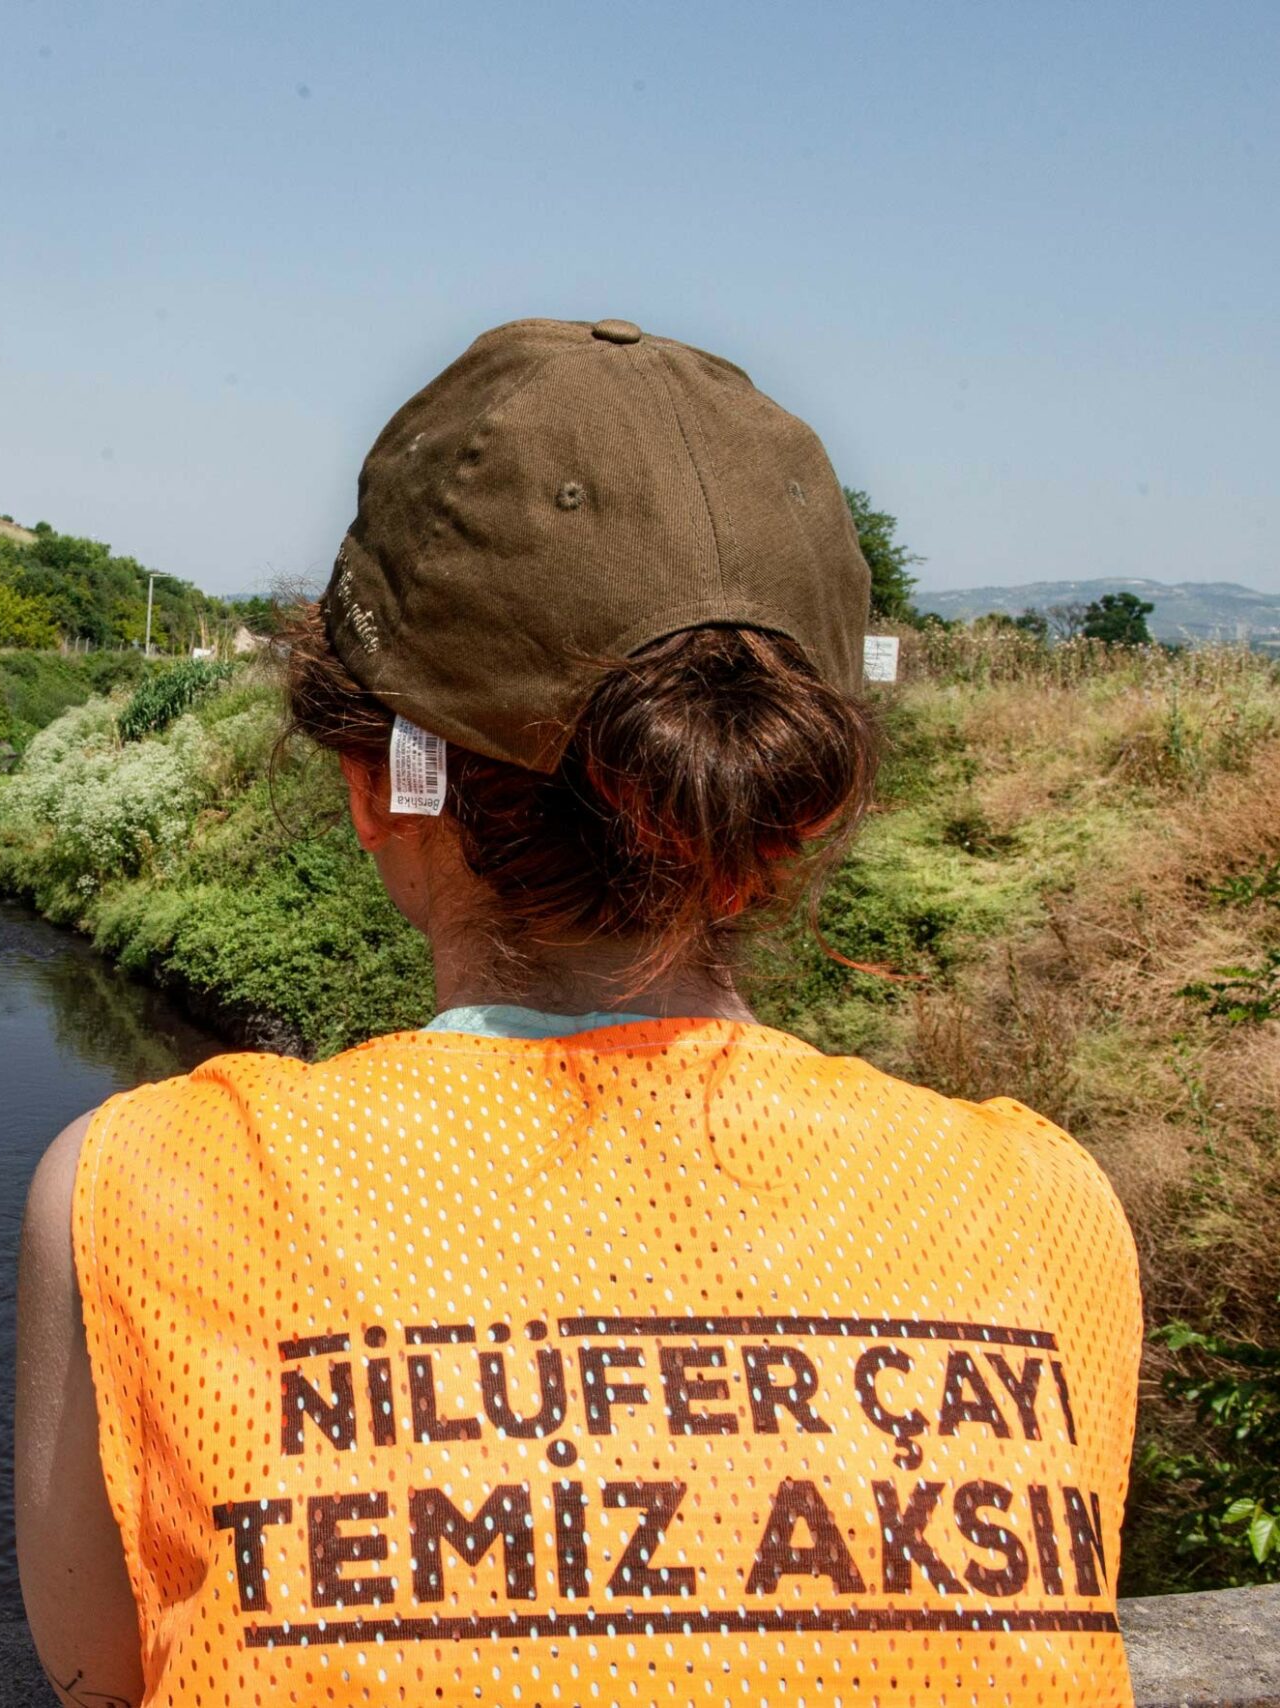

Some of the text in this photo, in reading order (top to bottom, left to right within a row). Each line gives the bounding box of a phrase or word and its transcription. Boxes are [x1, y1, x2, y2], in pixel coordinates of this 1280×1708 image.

[396, 795, 440, 811] Bershka
[280, 1319, 1078, 1471] NİLÜFER ÇAYI
[212, 1438, 1109, 1612] TEMİZ AKSIN
